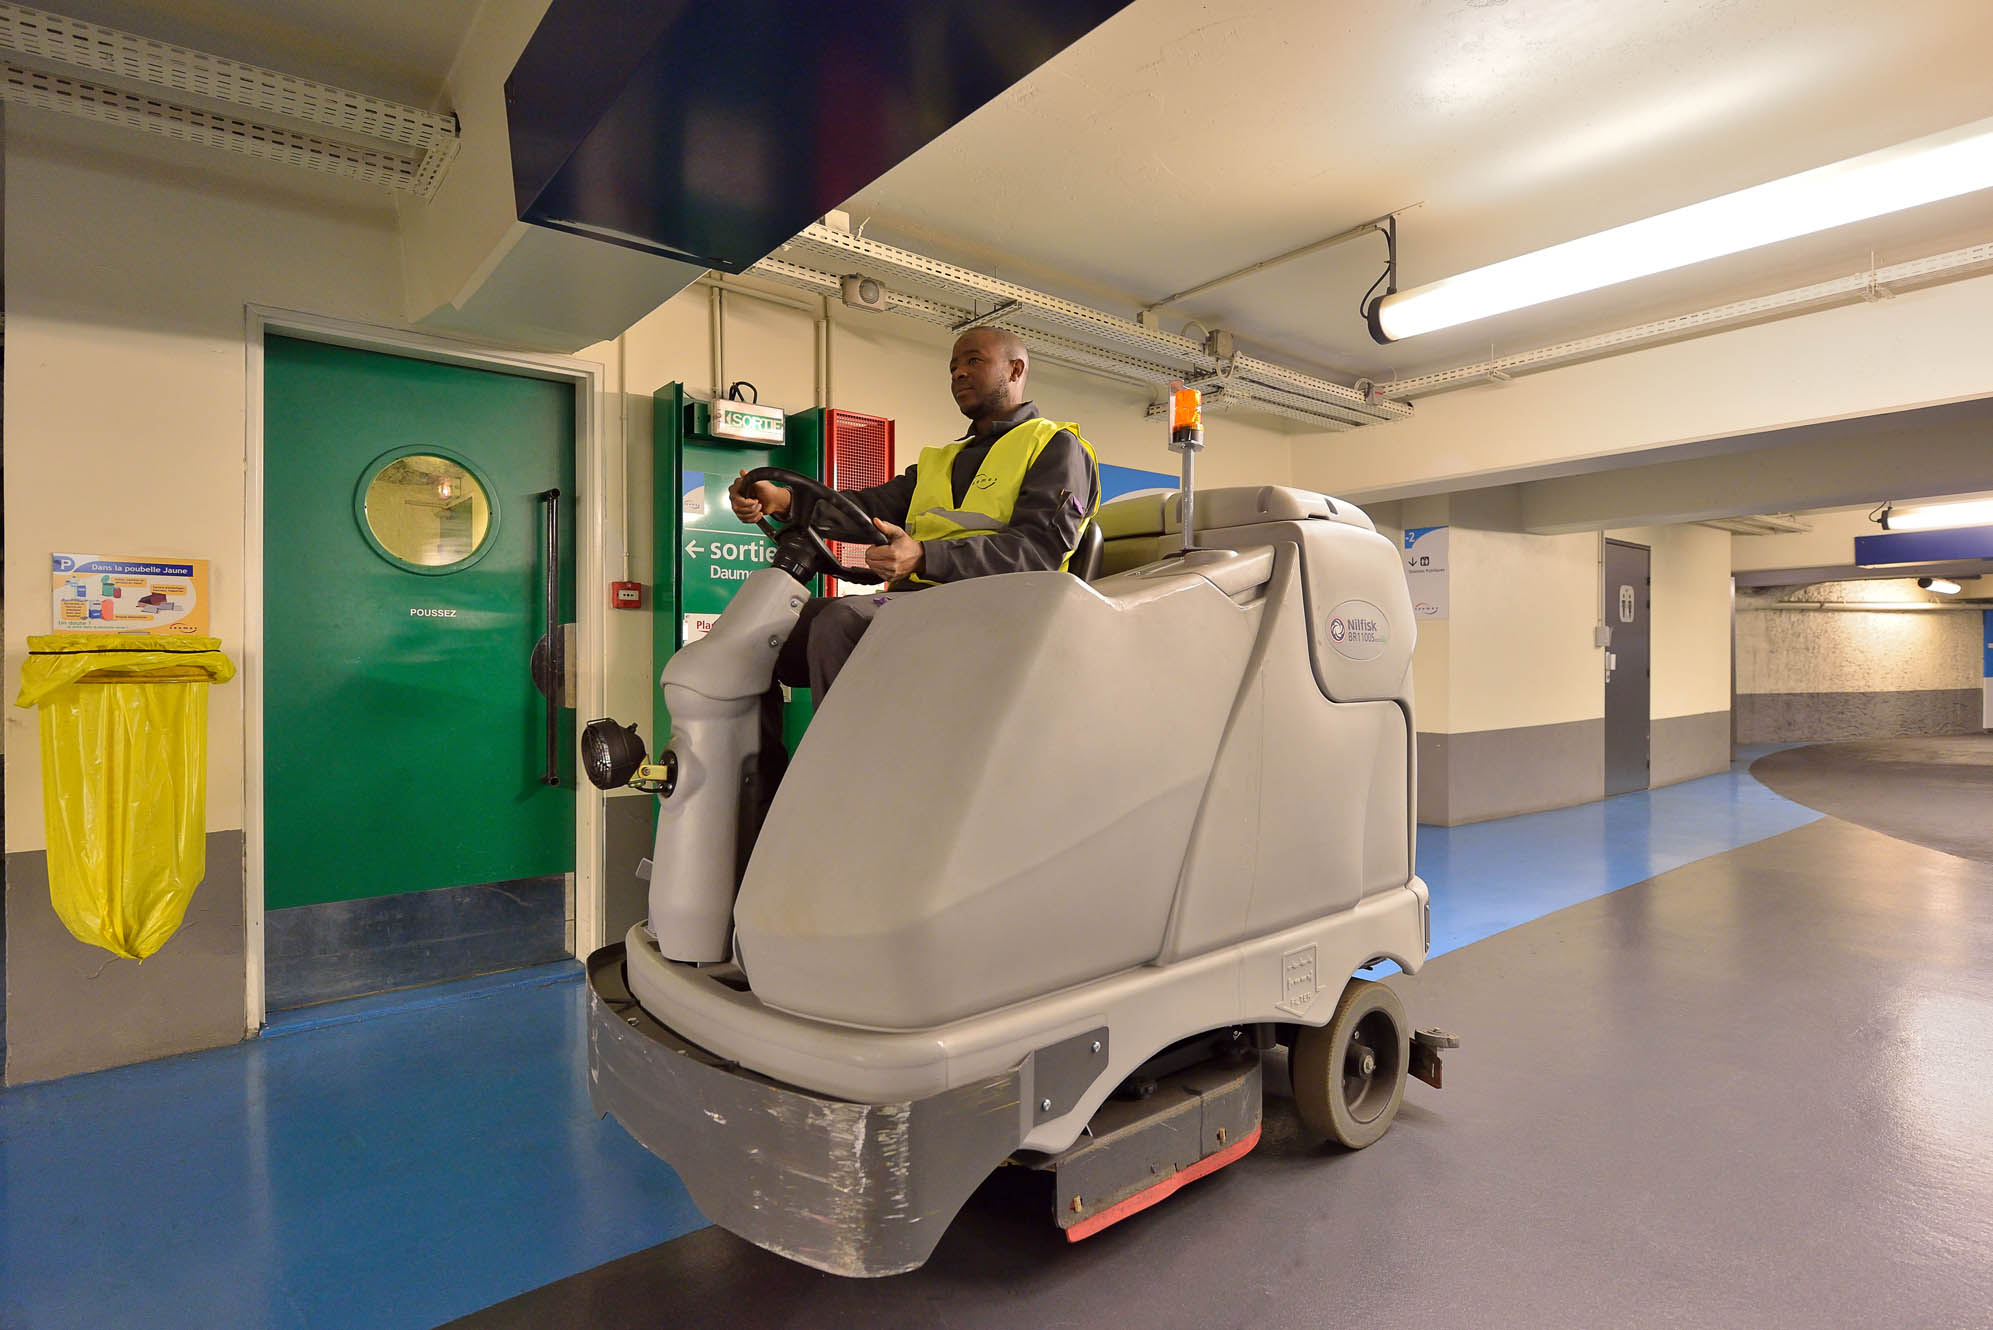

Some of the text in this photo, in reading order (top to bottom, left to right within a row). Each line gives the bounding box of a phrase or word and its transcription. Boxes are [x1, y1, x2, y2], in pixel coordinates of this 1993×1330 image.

[1405, 532, 1416, 543] -2
[710, 540, 777, 563] sortie
[60, 559, 72, 570] P
[91, 563, 188, 575] Dans la poubelle Jaune
[710, 565, 753, 580] Daum
[410, 608, 457, 618] POUSSEZ
[1347, 618, 1377, 632] Nilfisk
